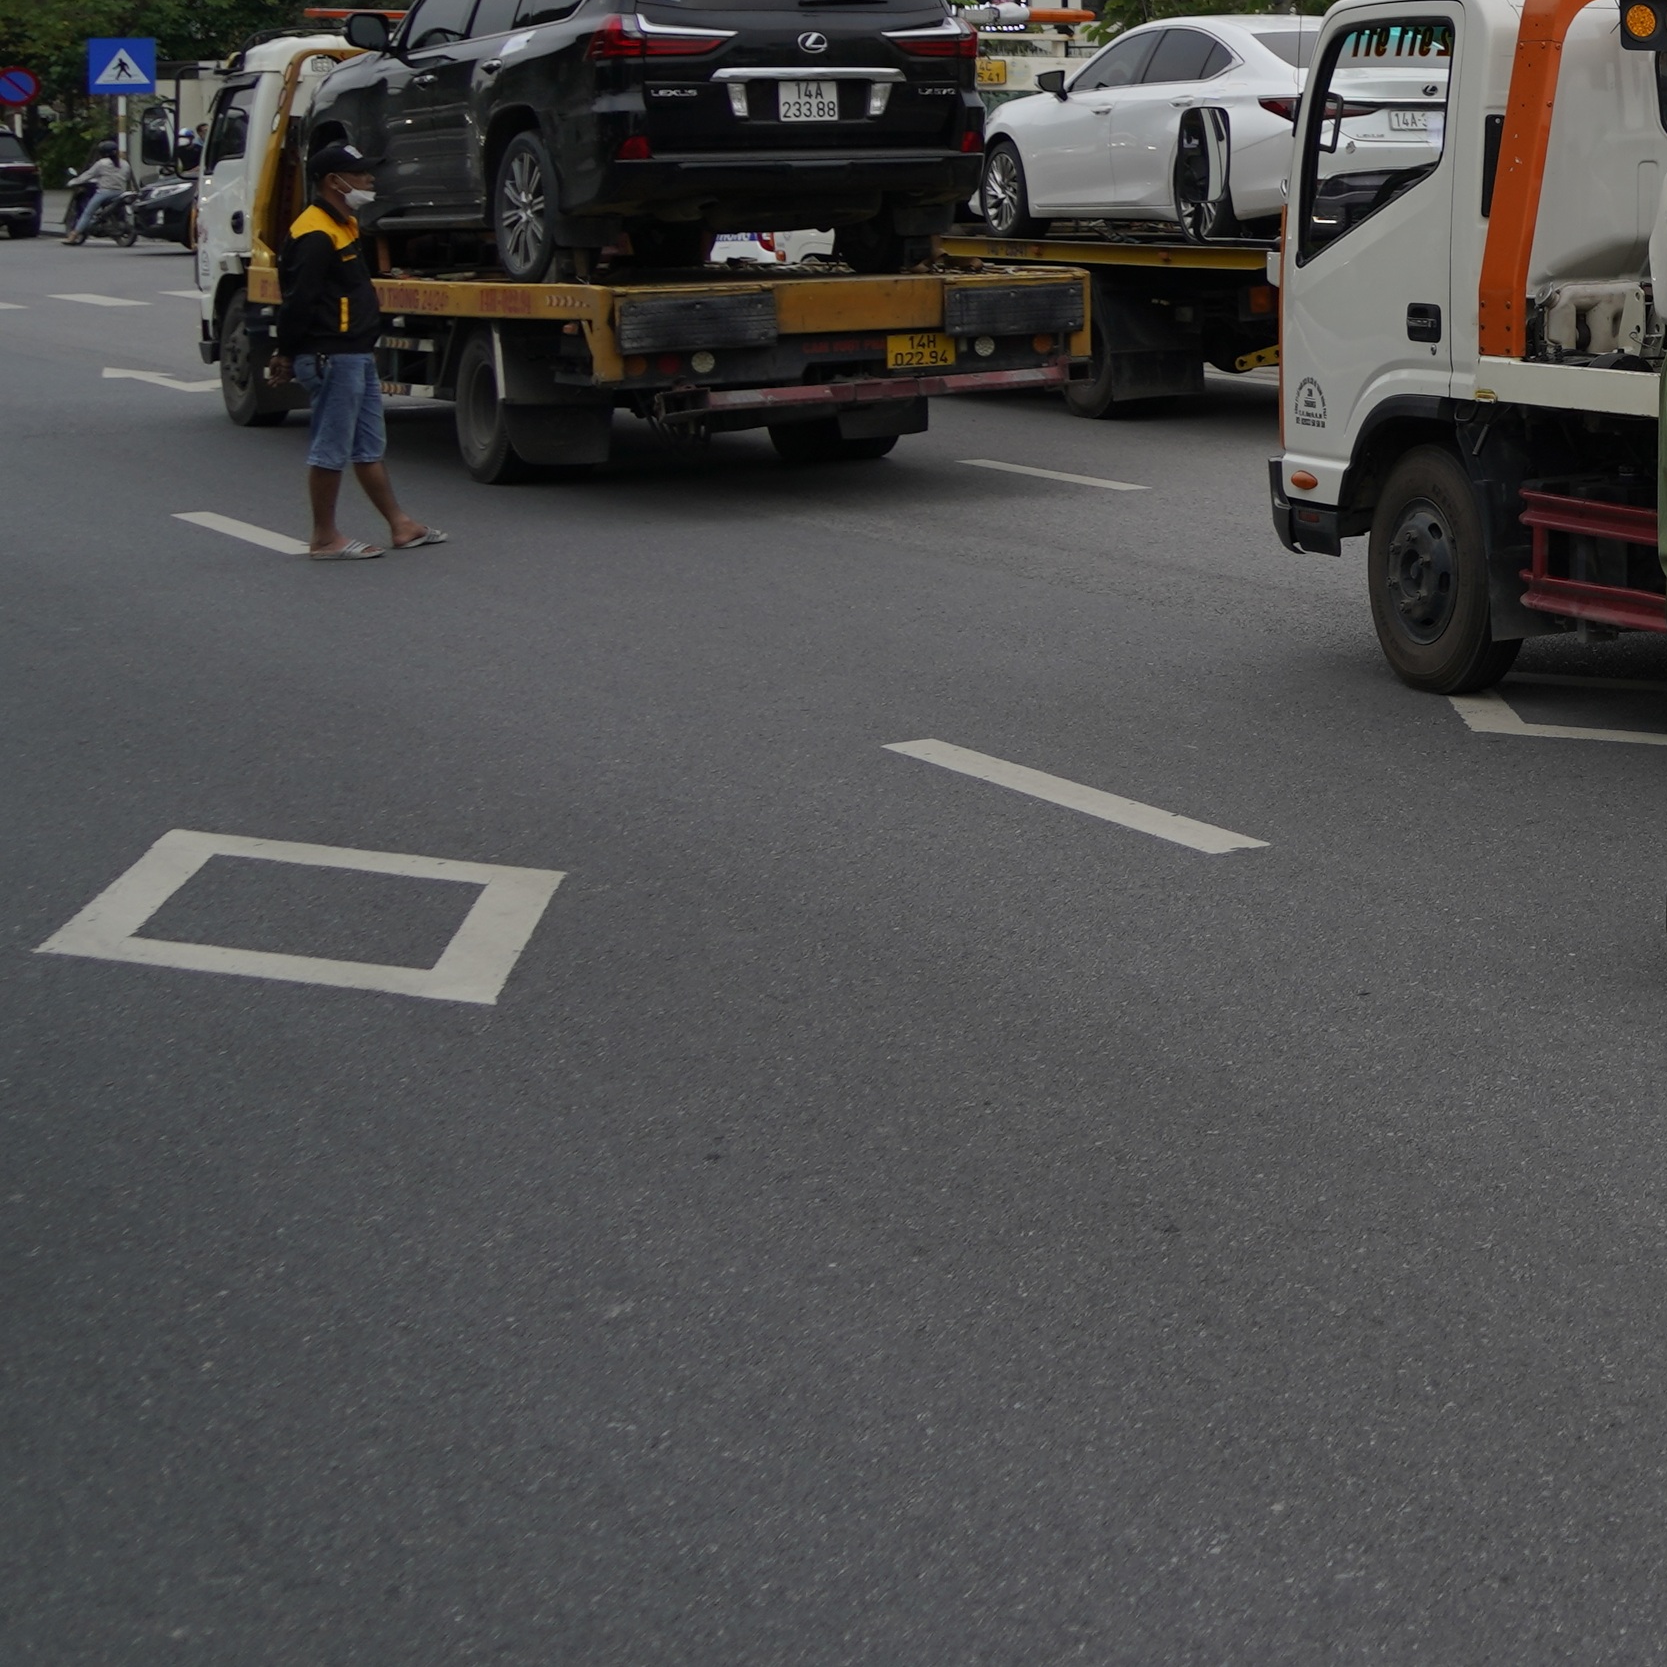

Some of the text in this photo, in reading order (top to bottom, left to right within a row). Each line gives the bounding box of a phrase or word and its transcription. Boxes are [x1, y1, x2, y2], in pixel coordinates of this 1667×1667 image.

[650, 88, 698, 97] LEXUS
[795, 82, 824, 100] 14A
[782, 101, 837, 118] 233.88
[908, 334, 937, 350] 14H
[894, 350, 948, 367] 022.94
